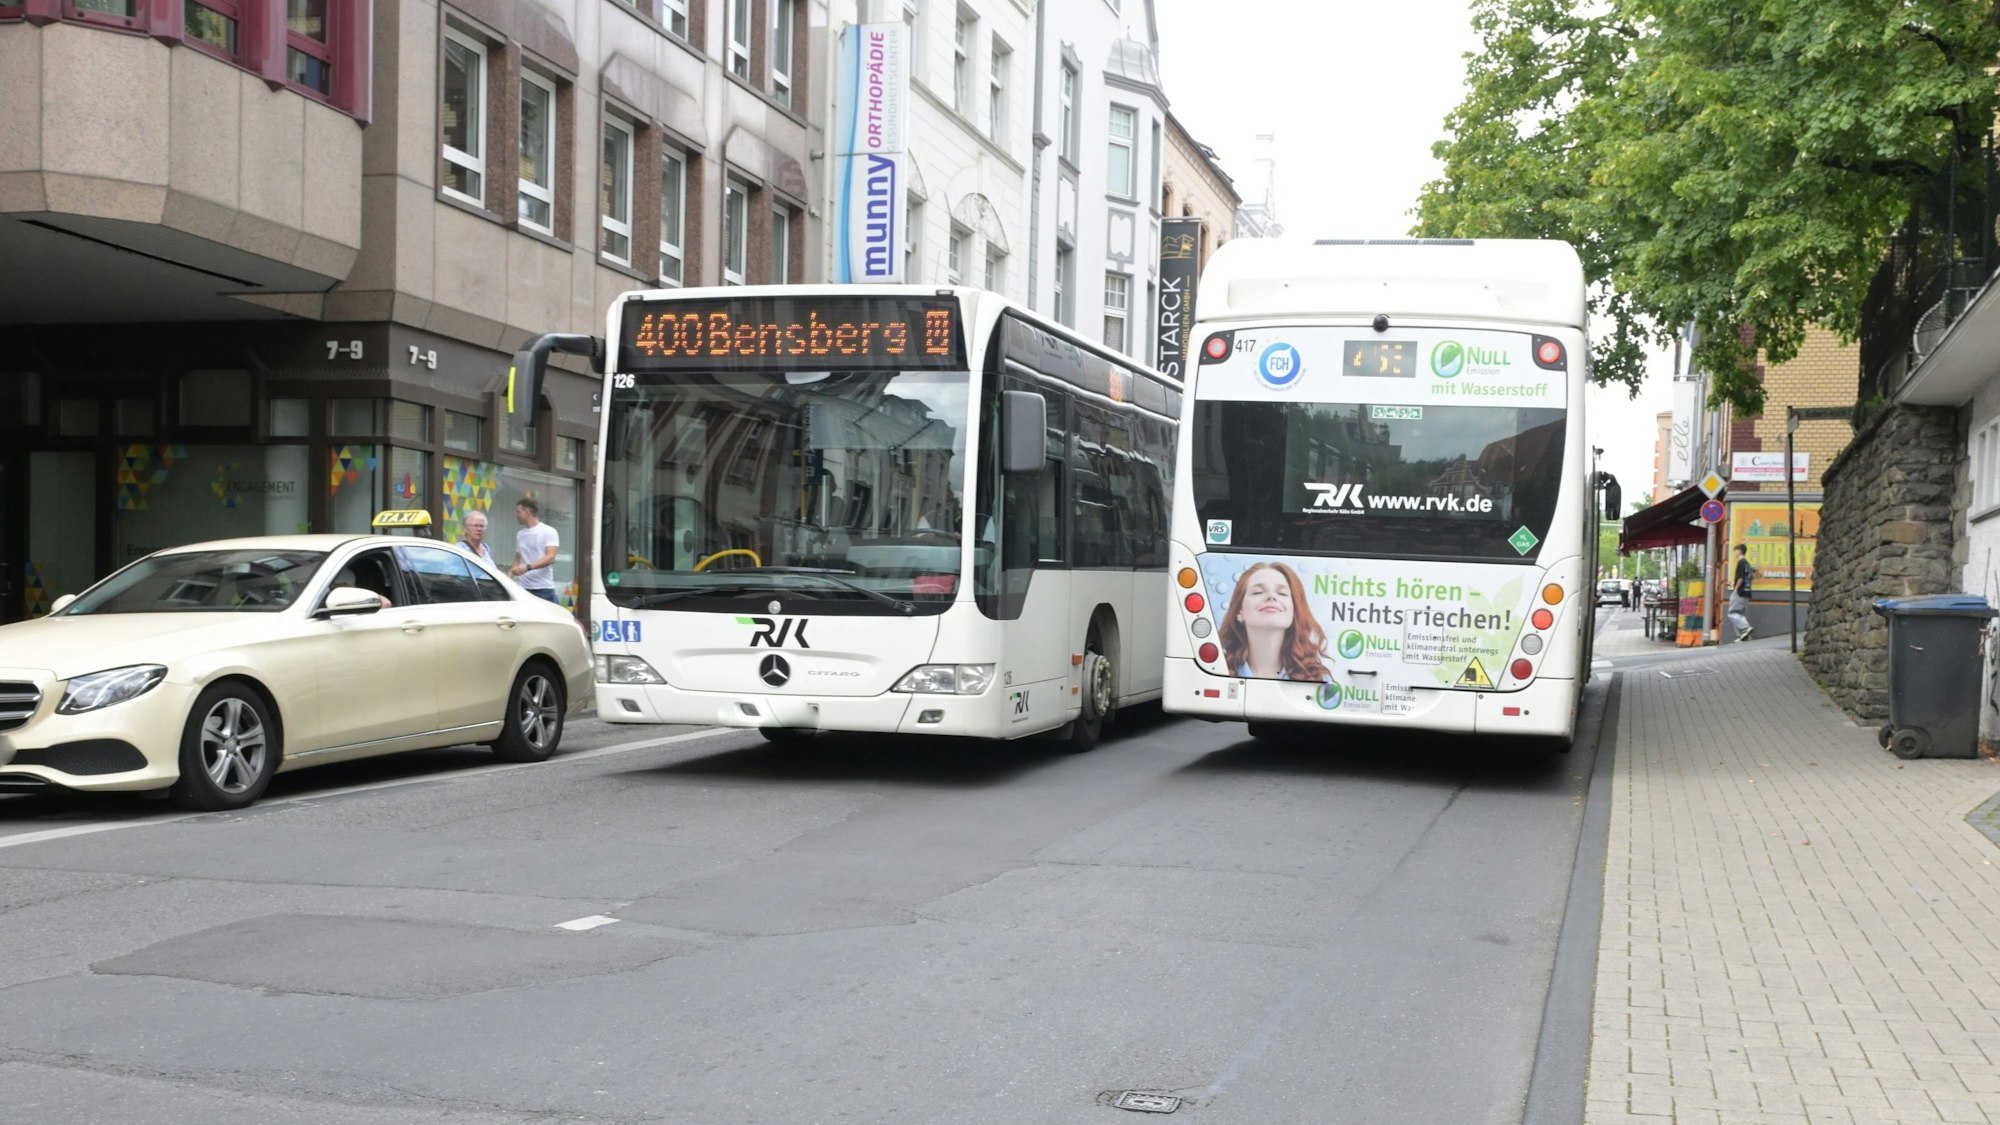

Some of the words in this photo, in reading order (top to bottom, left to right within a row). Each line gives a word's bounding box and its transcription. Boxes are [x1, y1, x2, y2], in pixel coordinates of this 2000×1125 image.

[866, 31, 884, 149] ORTHOPÄDIE
[887, 30, 899, 152] GESUNDHEITSCENTER
[865, 153, 895, 277] munny
[1183, 288, 1191, 312] GMBH
[636, 313, 702, 355] 400
[709, 311, 907, 355] Bensberg
[1160, 276, 1181, 376] STARCK
[1235, 339, 1256, 353] 417
[1270, 356, 1289, 371] FCH
[1466, 367, 1501, 376] Emission
[613, 373, 635, 389] 126
[1432, 382, 1457, 395] mit
[1461, 382, 1548, 397] Wasserstoff
[1304, 483, 1364, 508] RVK
[1368, 493, 1493, 513] www.rvk.de
[380, 511, 418, 523] TAXI
[1208, 525, 1225, 533] VRS
[1314, 574, 1387, 598] Nichts
[1396, 577, 1463, 601] hören
[1331, 601, 1404, 625] Nichts
[1413, 605, 1511, 631] riechen!
[736, 616, 810, 649] RVK
[1407, 632, 1459, 644] Emissionsfrei
[1461, 636, 1477, 644] und
[1365, 650, 1393, 659] Emission
[1406, 643, 1456, 653] klimaneutral
[1458, 647, 1499, 656] unterwegs
[1406, 653, 1420, 661] mit
[1422, 654, 1468, 663] Wasserstoff
